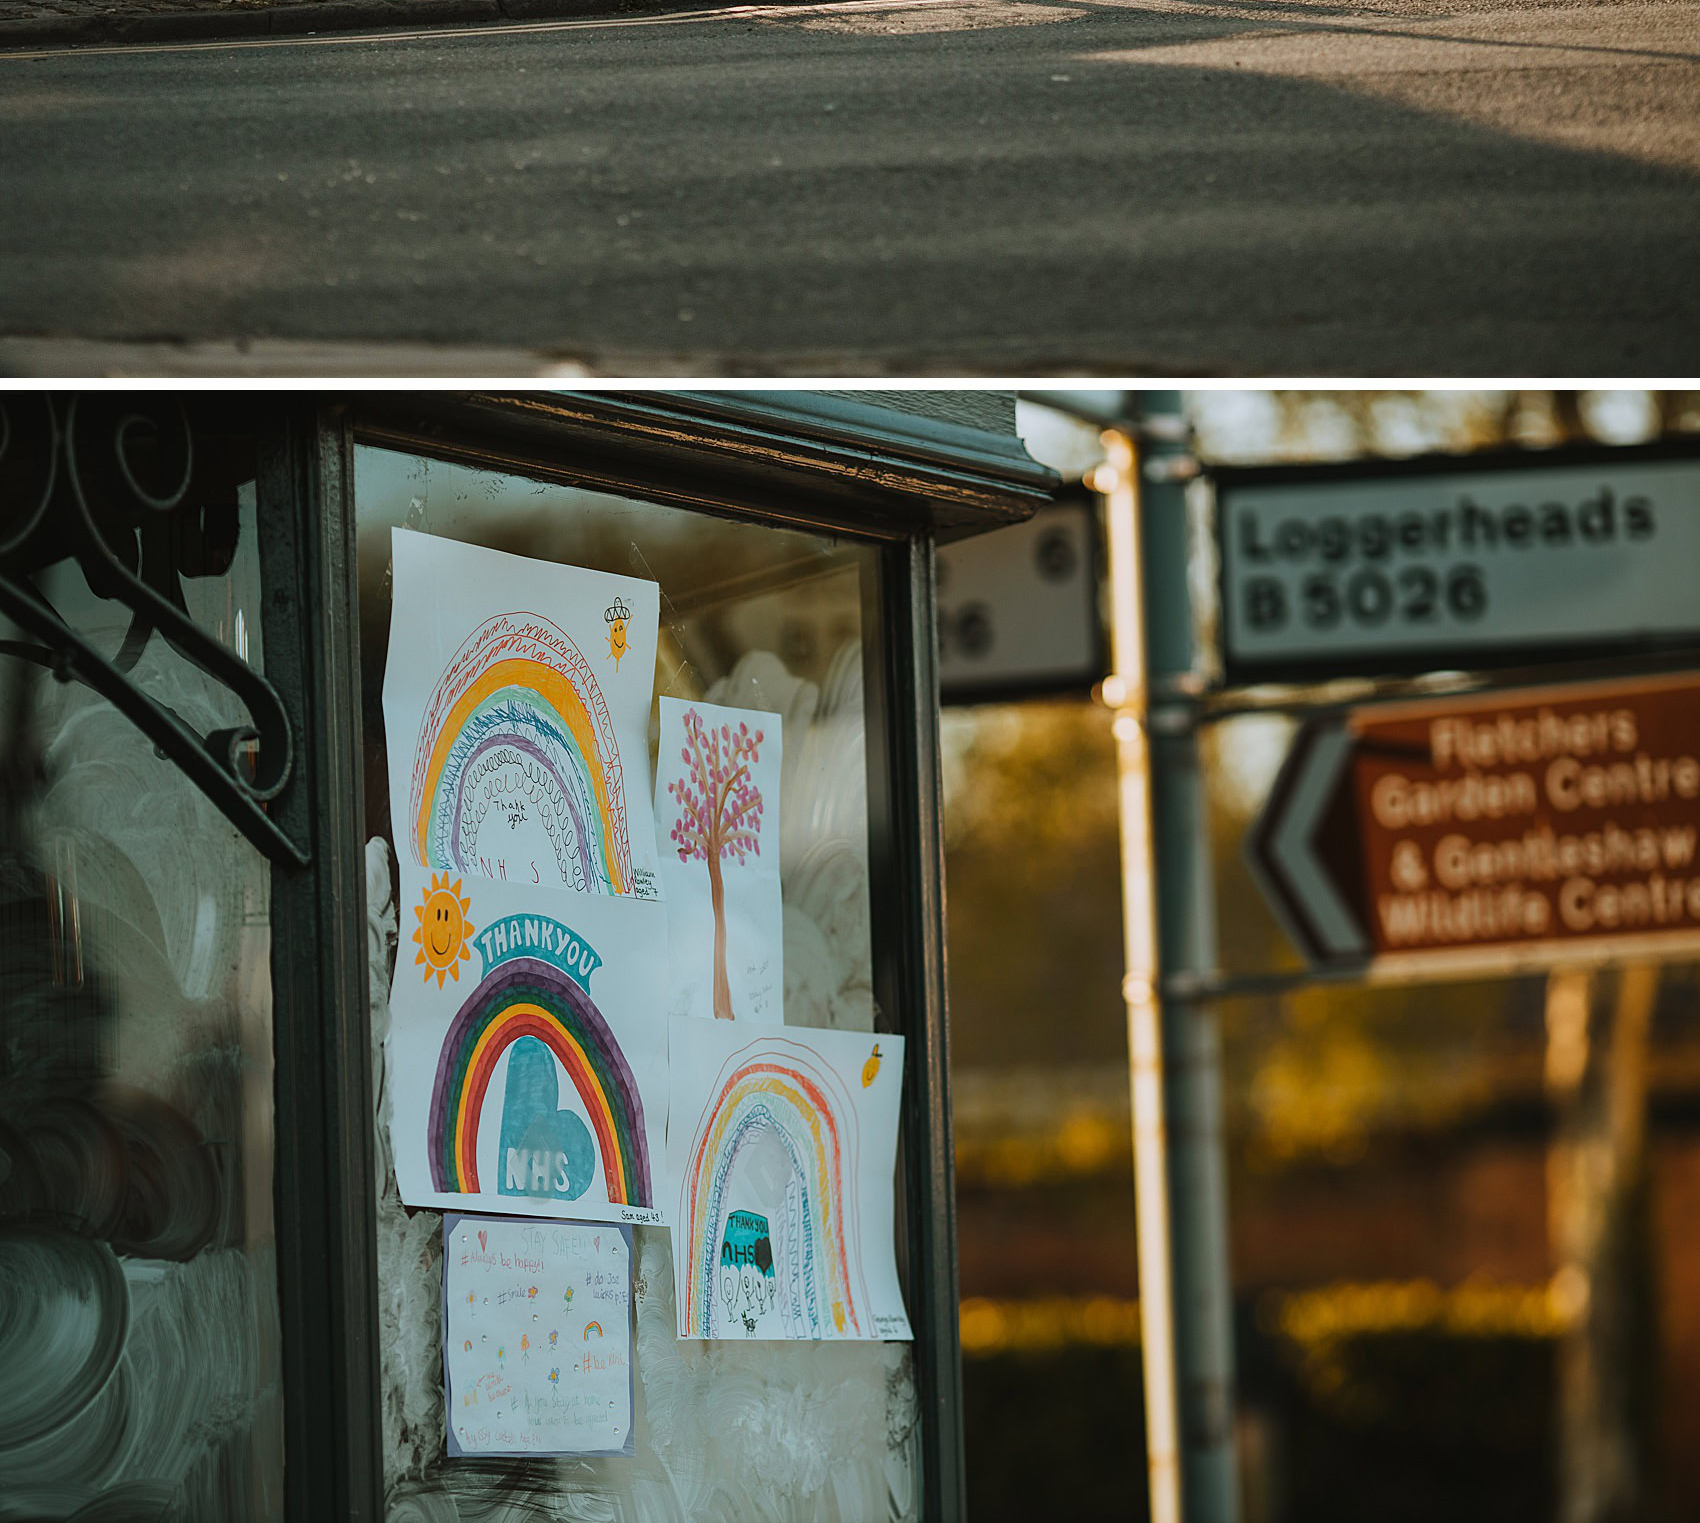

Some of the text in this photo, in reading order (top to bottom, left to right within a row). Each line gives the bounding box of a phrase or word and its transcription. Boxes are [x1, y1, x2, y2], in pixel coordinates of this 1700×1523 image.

[1238, 484, 1656, 565] Loggerheads
[1302, 563, 1488, 632] 5026
[1430, 708, 1638, 771] Fletchers
[493, 799, 526, 812] Thank
[507, 812, 528, 830] you
[1372, 754, 1700, 829] Garden Centre
[1435, 821, 1696, 890] Gentleshaw
[1378, 883, 1550, 943] Wildlife
[506, 1147, 570, 1193] NHS
[522, 1227, 547, 1253] STAY
